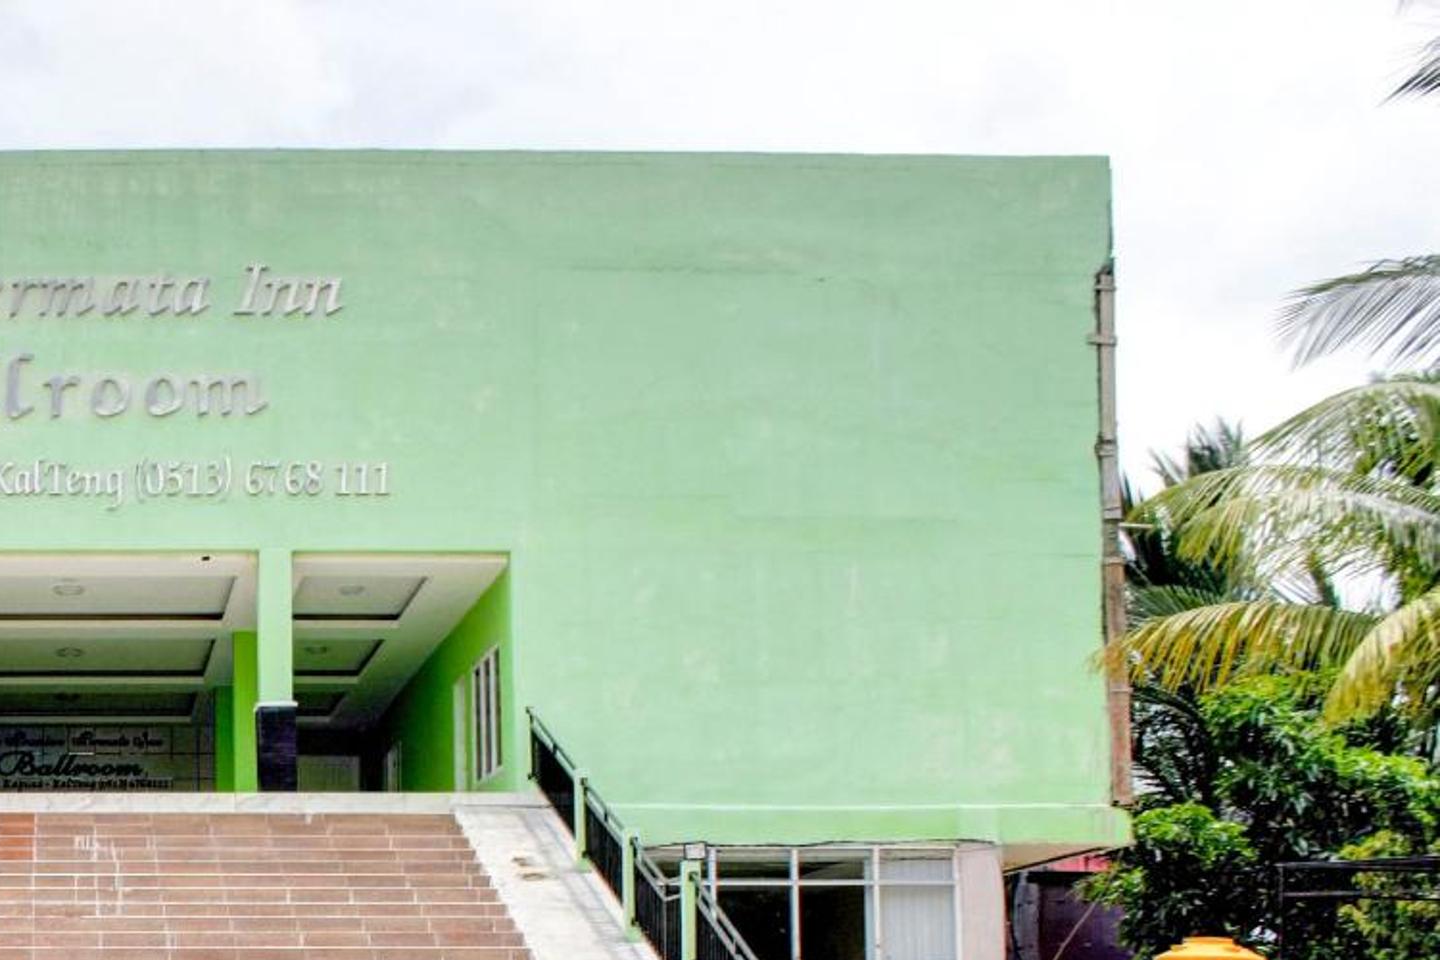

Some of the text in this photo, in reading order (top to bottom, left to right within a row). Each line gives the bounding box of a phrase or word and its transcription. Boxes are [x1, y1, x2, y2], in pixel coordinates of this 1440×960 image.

[232, 262, 344, 317] Inn
[135, 456, 232, 502] (0513)
[246, 460, 322, 497] 6768
[334, 461, 391, 497] 111
